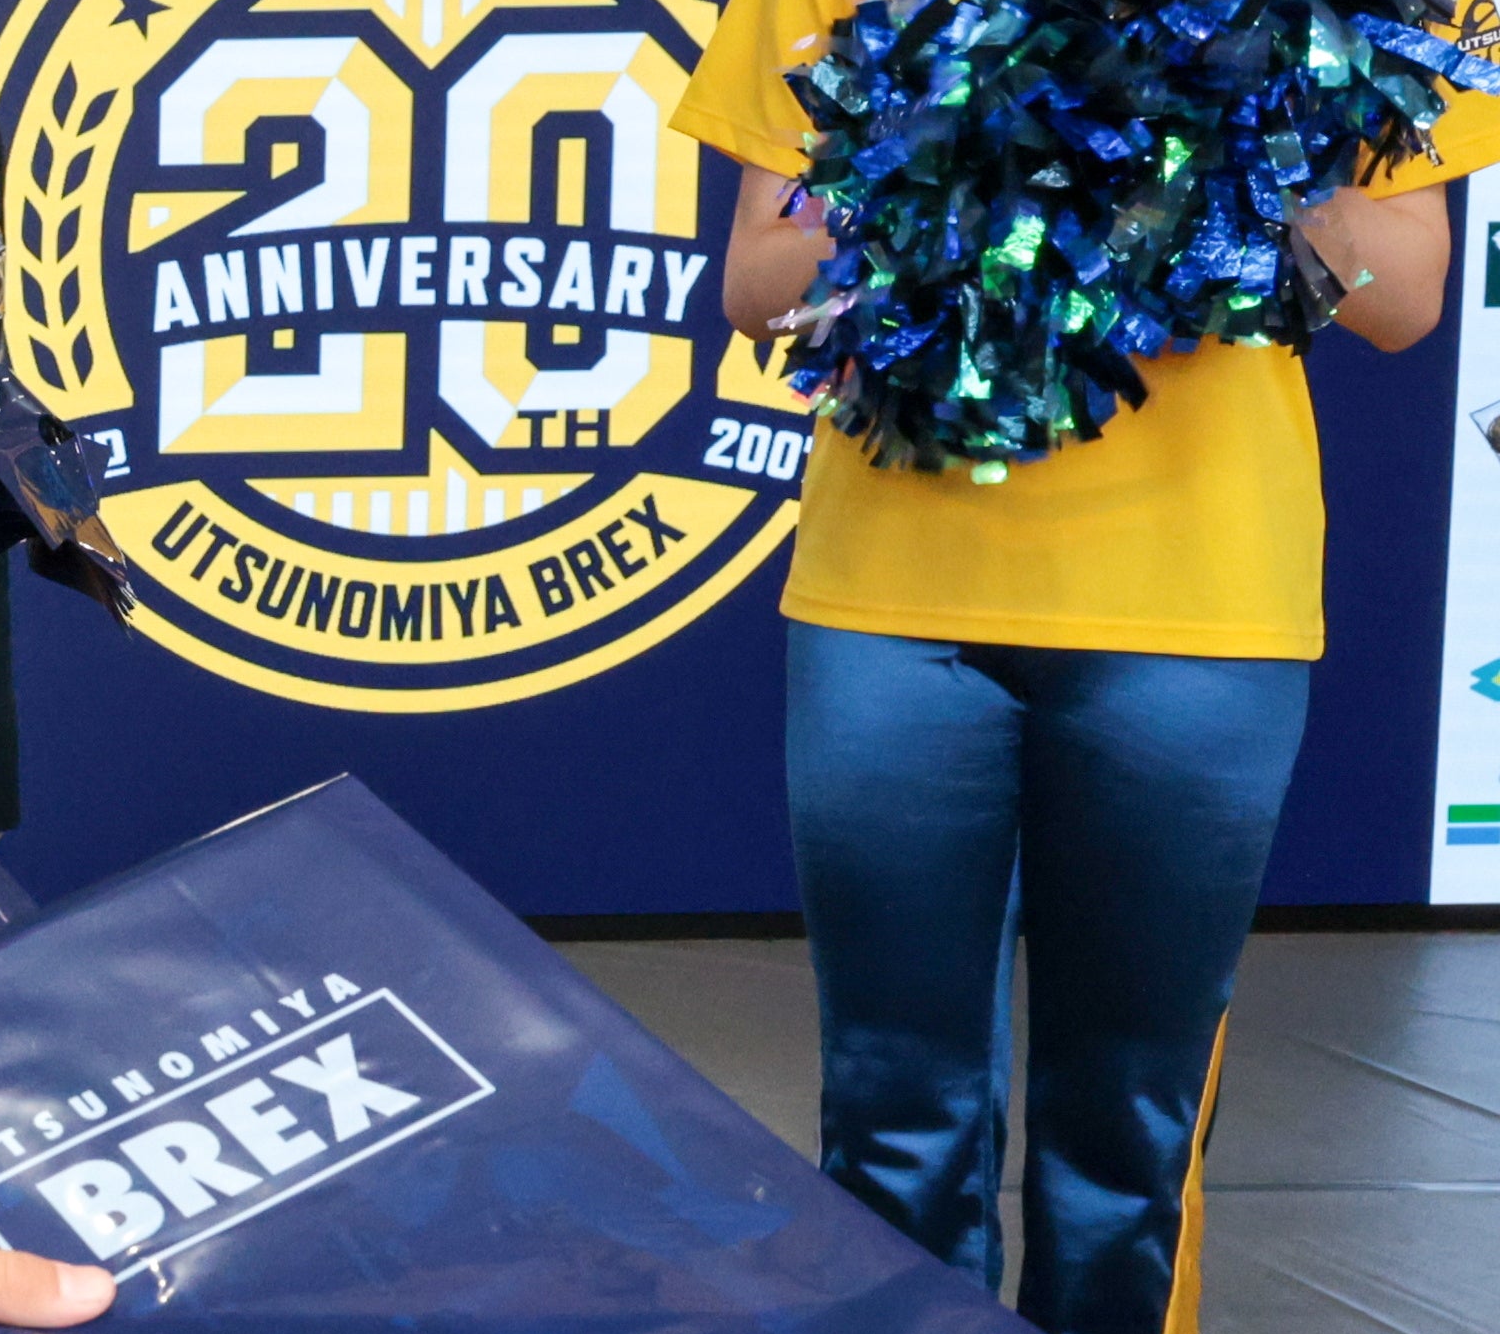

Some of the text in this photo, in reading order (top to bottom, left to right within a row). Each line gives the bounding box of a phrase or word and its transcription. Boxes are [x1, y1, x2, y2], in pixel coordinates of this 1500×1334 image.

[153, 234, 707, 333] ANNIVERSARY
[518, 410, 610, 448] TH
[703, 417, 813, 481] 200
[151, 493, 688, 643] UTSUNOMIYA BREX
[36, 1033, 421, 1262] BREX
